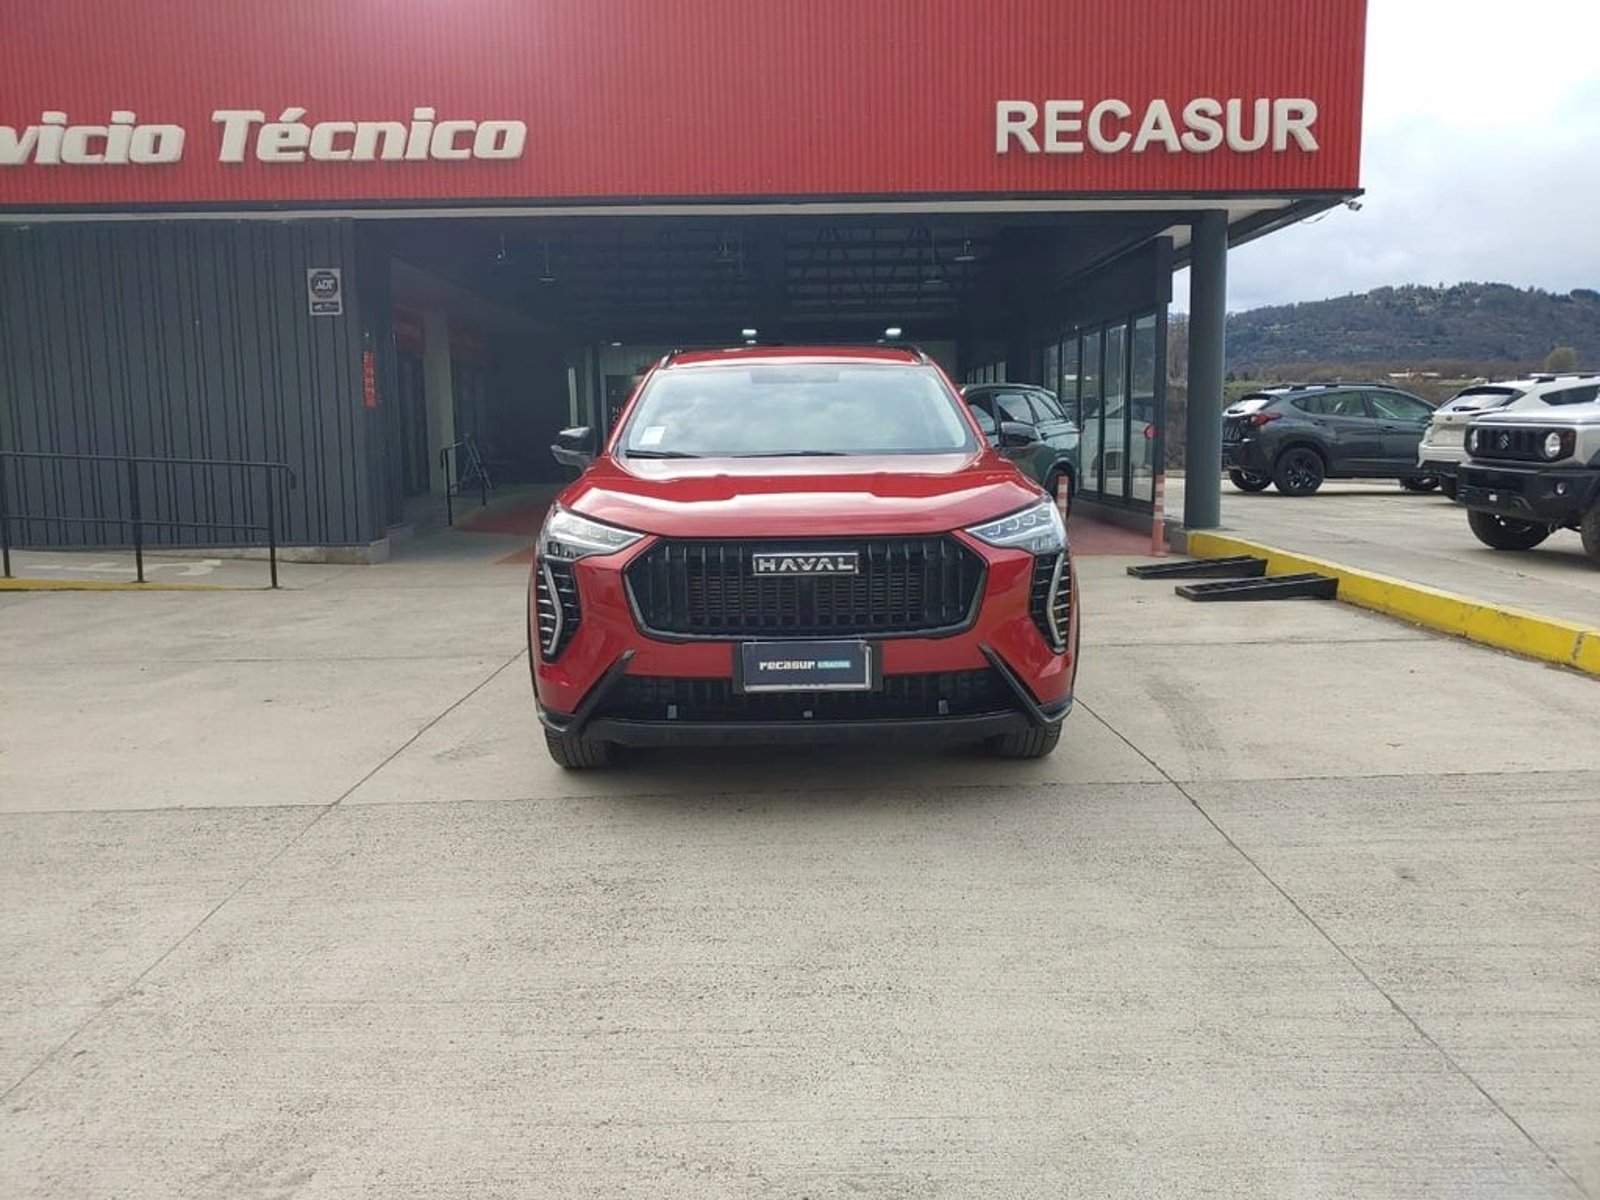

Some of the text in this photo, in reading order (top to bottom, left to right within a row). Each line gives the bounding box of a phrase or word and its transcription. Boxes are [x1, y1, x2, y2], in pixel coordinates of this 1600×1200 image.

[995, 97, 1319, 154] RECASUR
[0, 107, 527, 165] vicio Técnico
[315, 279, 335, 290] ADT
[758, 557, 854, 572] HAVAL
[759, 660, 815, 671] recasur
